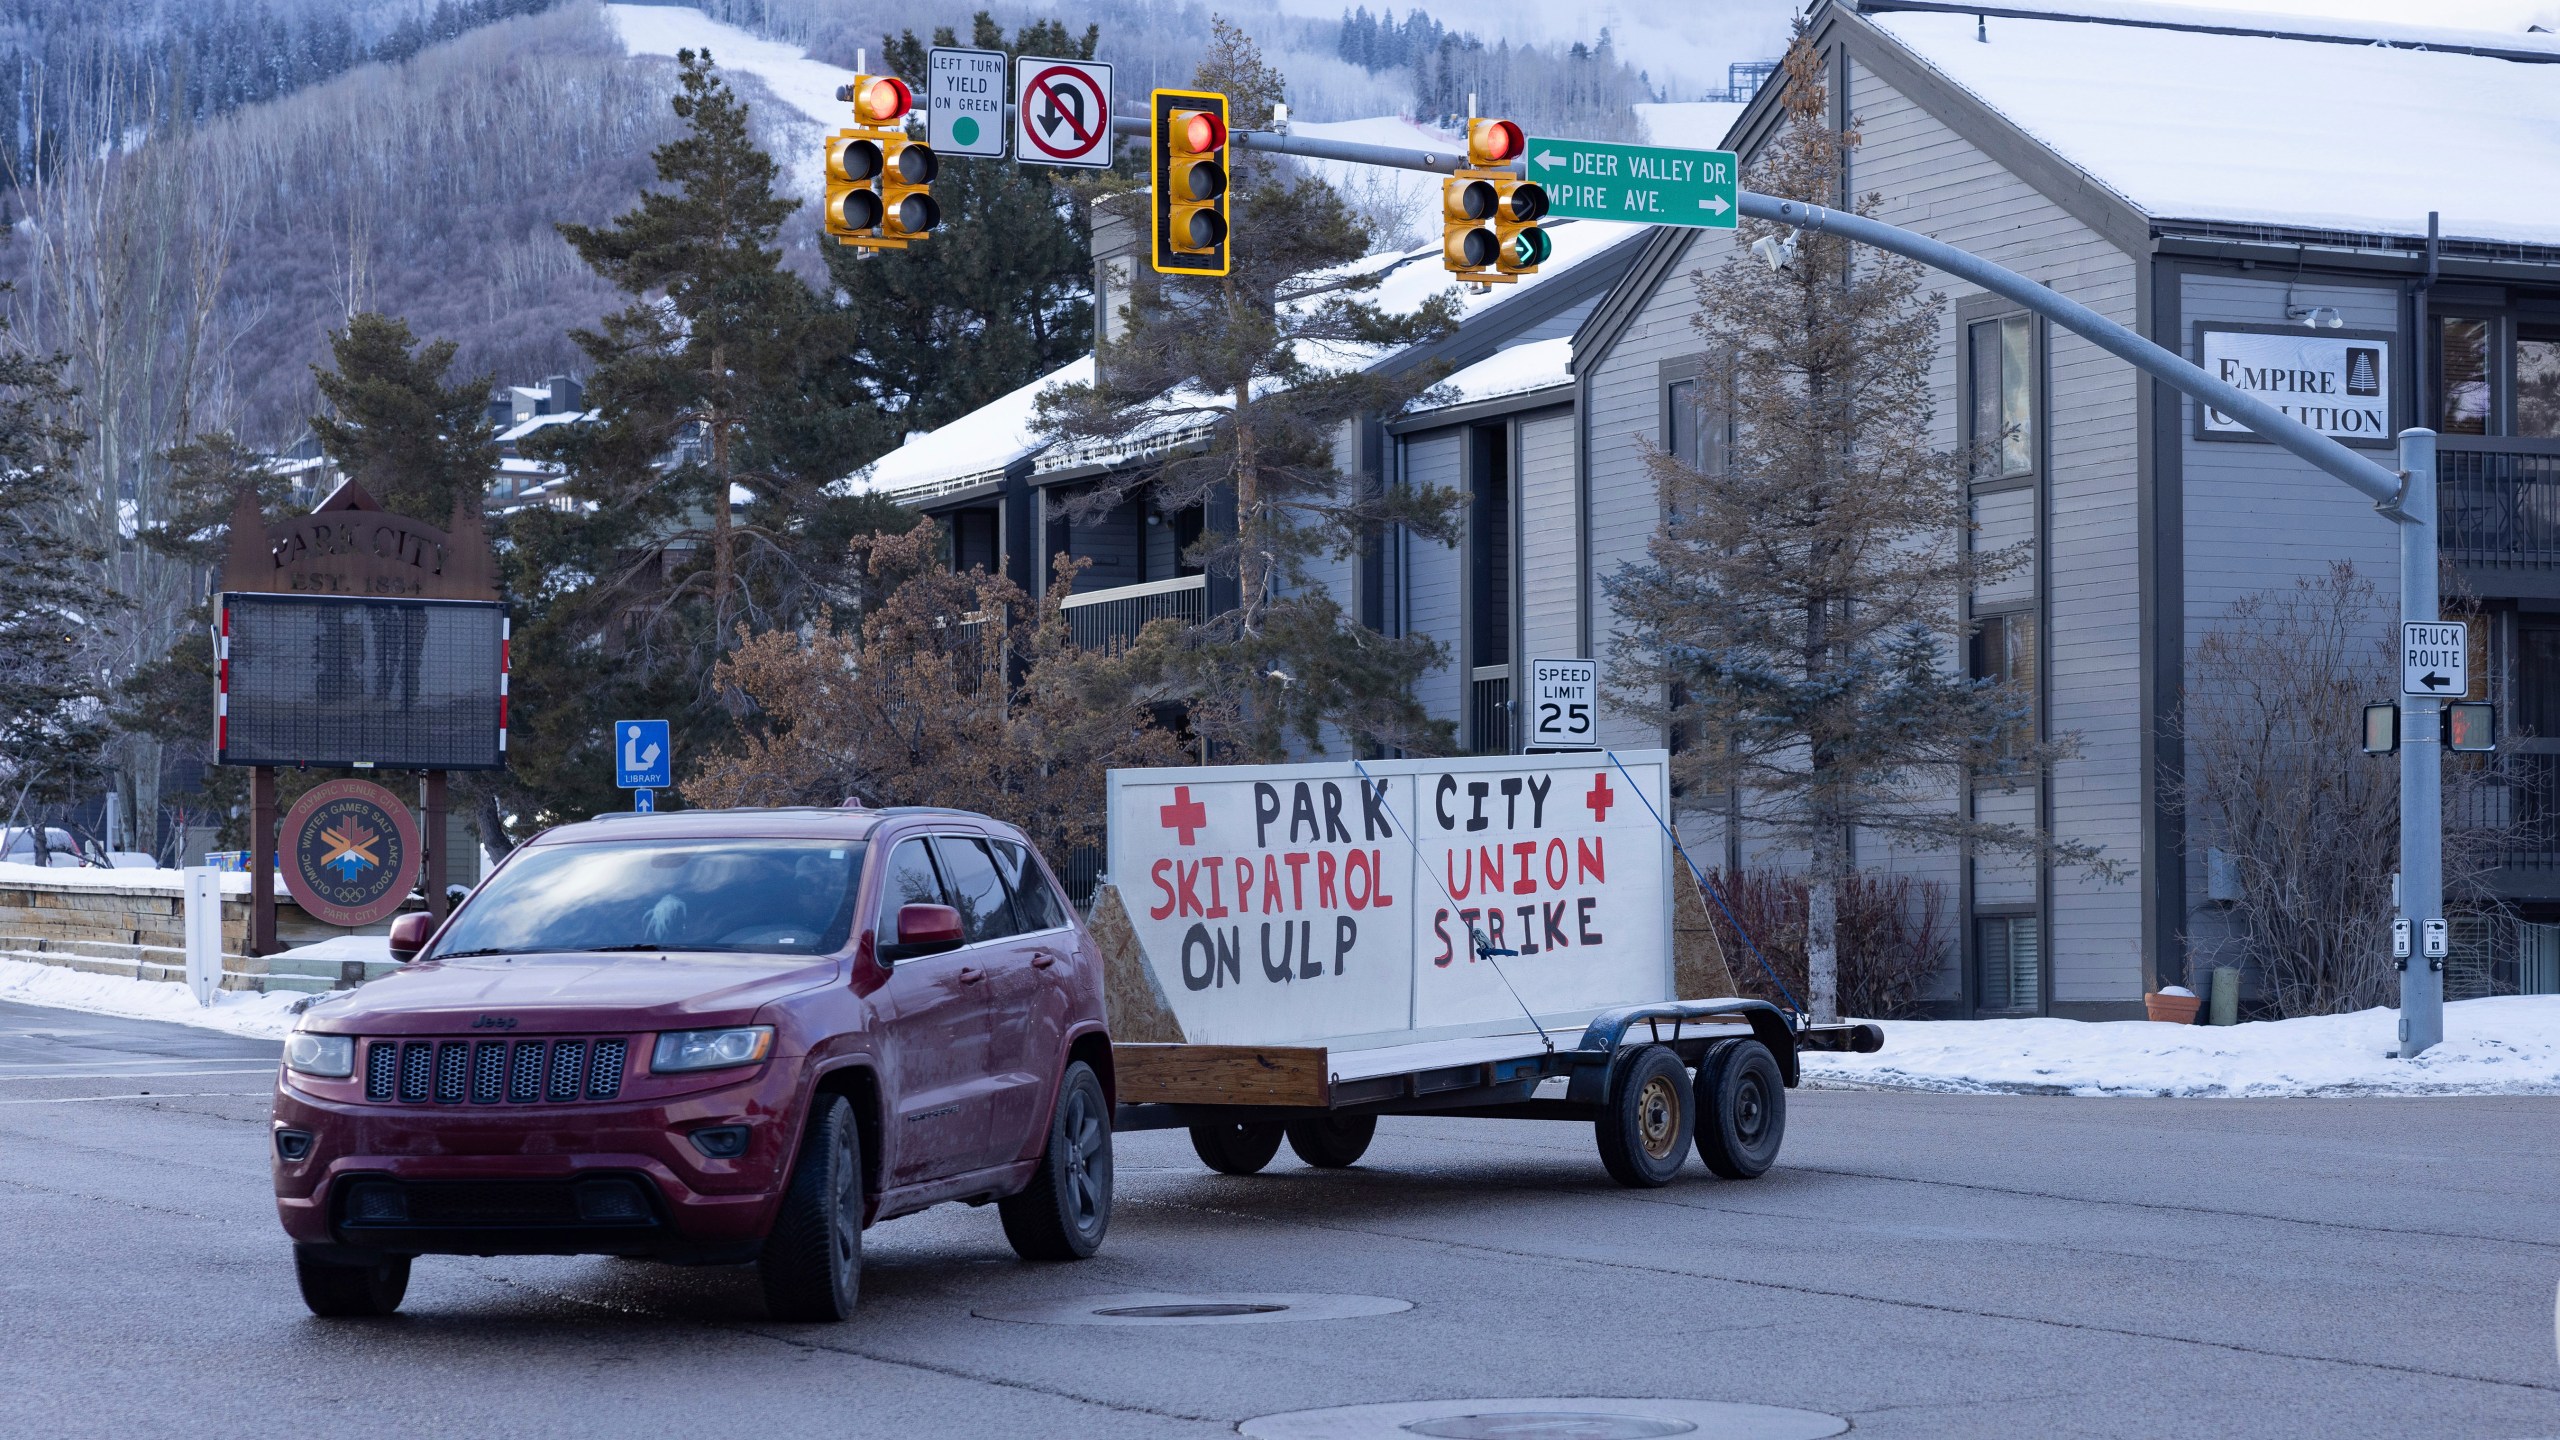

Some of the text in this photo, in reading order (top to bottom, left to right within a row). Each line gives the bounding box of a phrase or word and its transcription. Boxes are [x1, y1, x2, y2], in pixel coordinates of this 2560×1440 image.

[933, 57, 1001, 73] LEFT TURN
[946, 75, 987, 94] YIELD
[935, 96, 998, 112] ON GREEN
[1573, 152, 1732, 185] DEER VALLEY DR.
[1536, 182, 1665, 213] MPIRE AVE.
[272, 522, 451, 576] PARK CITY
[290, 571, 350, 592] EST.
[2409, 628, 2460, 646] TRUCK
[2409, 649, 2460, 668] ROUTE
[1538, 668, 1591, 682] SPEED
[1544, 685, 1585, 699] LIMIT
[1539, 702, 1590, 734] 25
[624, 774, 662, 783] LIBRARY
[298, 783, 401, 815] OLYMPIC VENUE CITY
[1253, 773, 1552, 849] PARK CITY
[301, 803, 397, 895] OLYMPIC WINTER GAMES SALT LAKE 2002
[1447, 836, 1605, 901] UNION
[323, 906, 378, 921] PARK CITY
[1181, 921, 1241, 992] ON
[1434, 896, 1603, 969] STRIKE
[471, 1013, 519, 1031] Jeep
